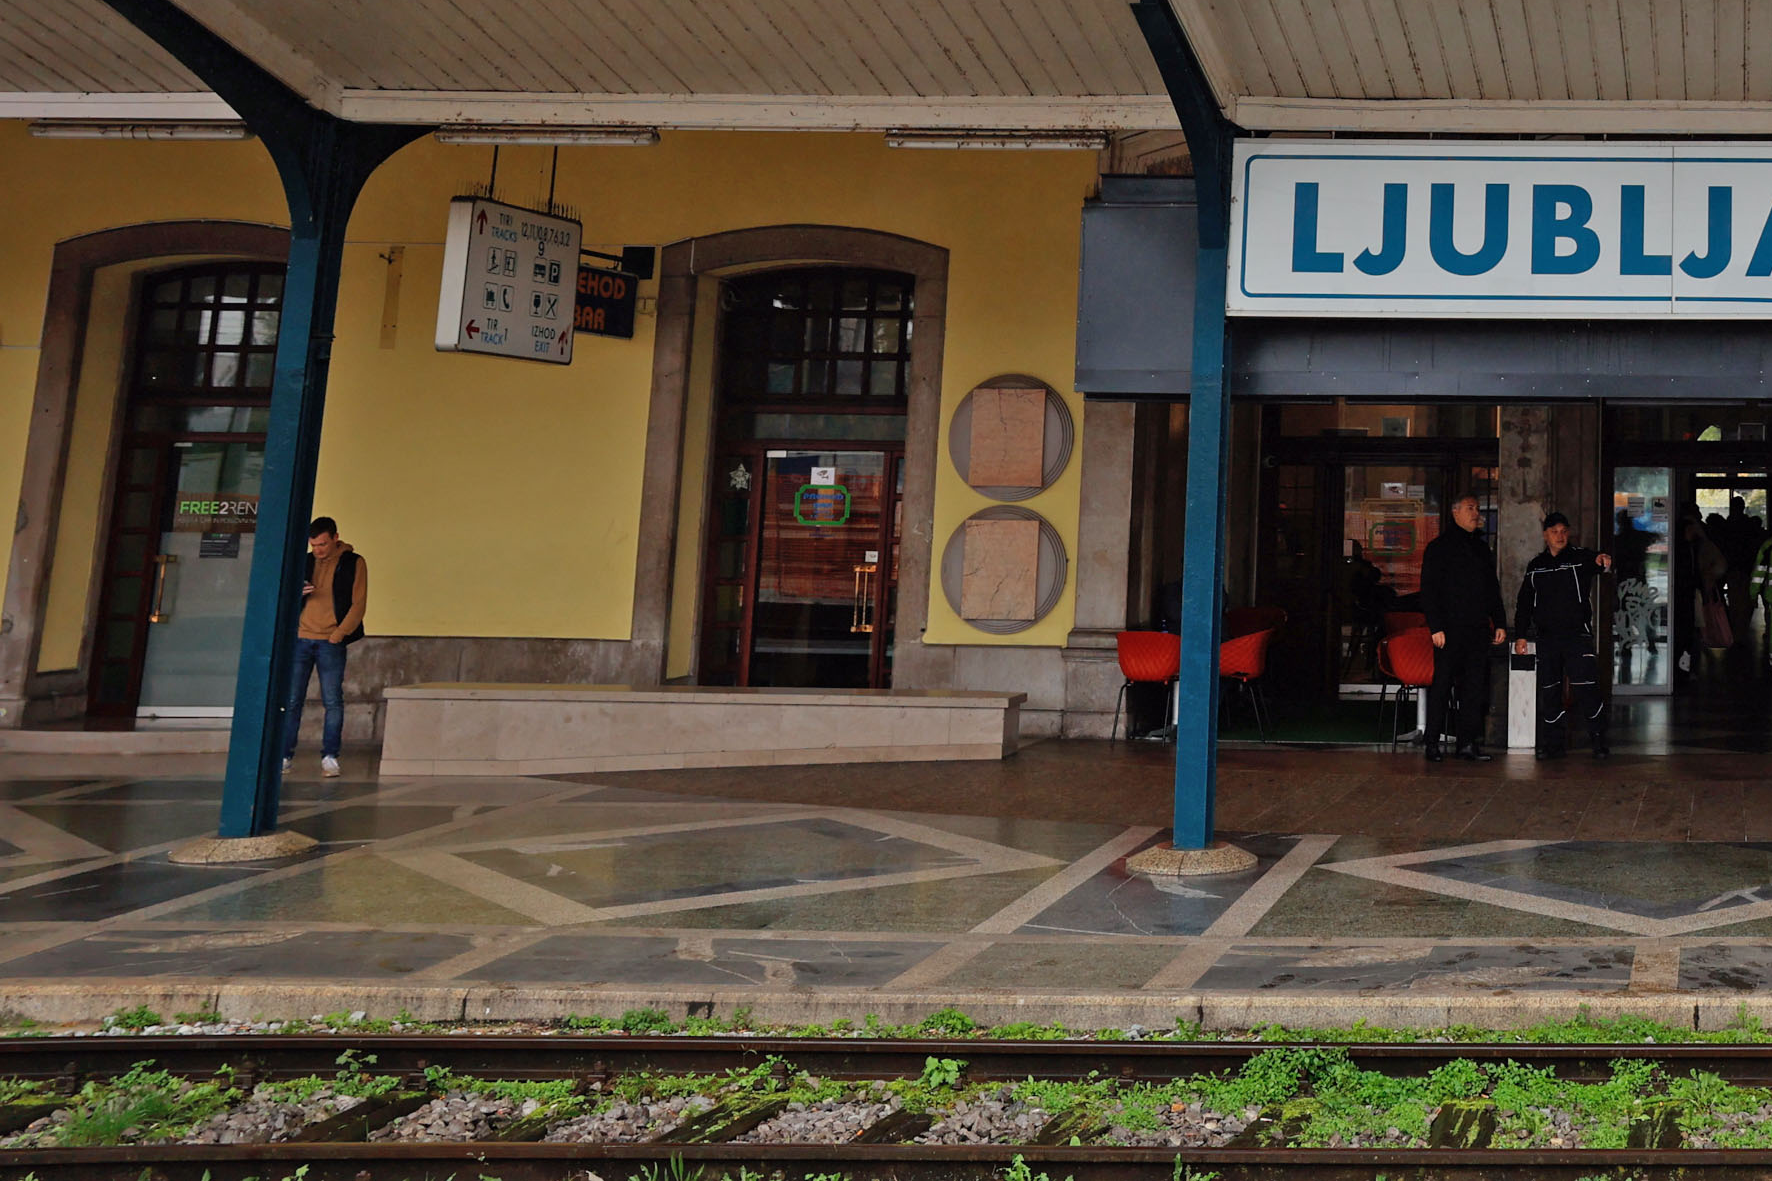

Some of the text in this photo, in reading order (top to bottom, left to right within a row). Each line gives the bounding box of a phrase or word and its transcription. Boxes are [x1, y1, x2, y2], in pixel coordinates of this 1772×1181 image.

[500, 213, 513, 227] TIRI
[491, 226, 517, 243] TRACKS
[538, 241, 545, 257] 9
[487, 318, 498, 332] TIR
[480, 331, 504, 346] TRACK
[531, 326, 556, 340] IZHOD
[535, 341, 550, 353] EXIT
